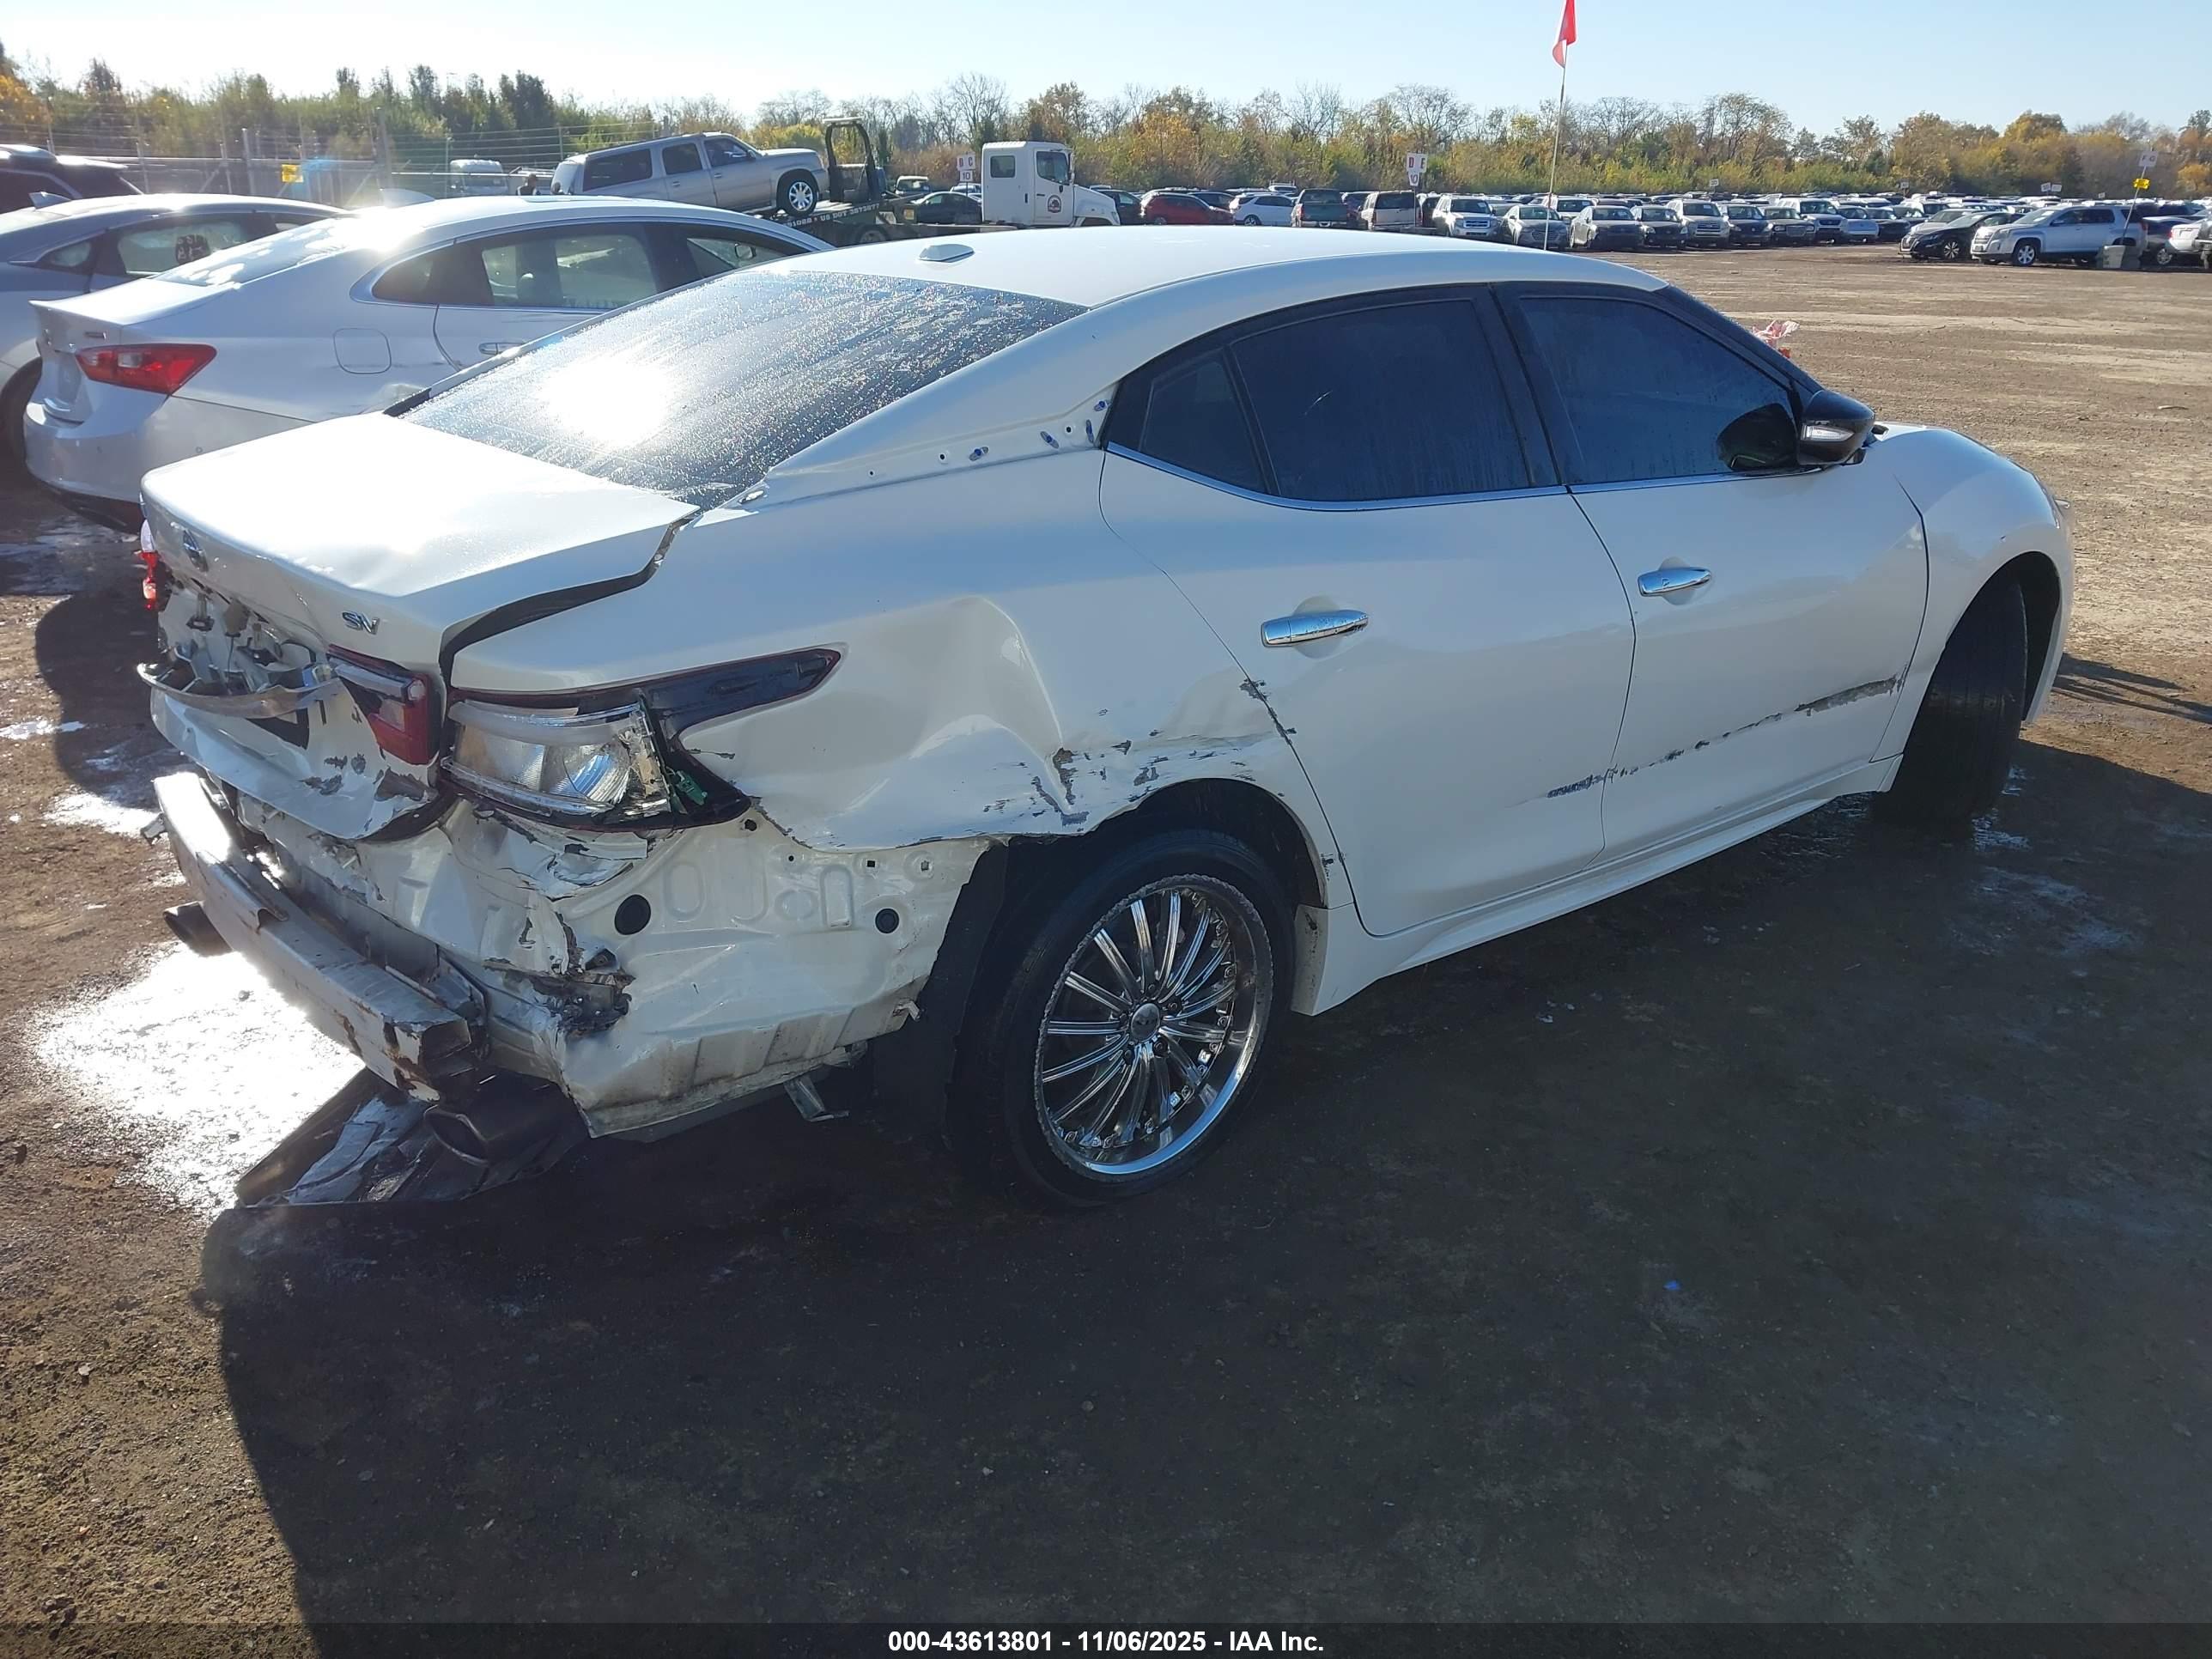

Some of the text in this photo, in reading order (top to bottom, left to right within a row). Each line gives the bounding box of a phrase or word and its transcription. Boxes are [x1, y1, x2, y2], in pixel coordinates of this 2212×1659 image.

[968, 156, 974, 167] C
[1408, 156, 1426, 169] D E
[963, 172, 970, 180] 10
[832, 210, 848, 219] DOT
[342, 611, 380, 635] SV
